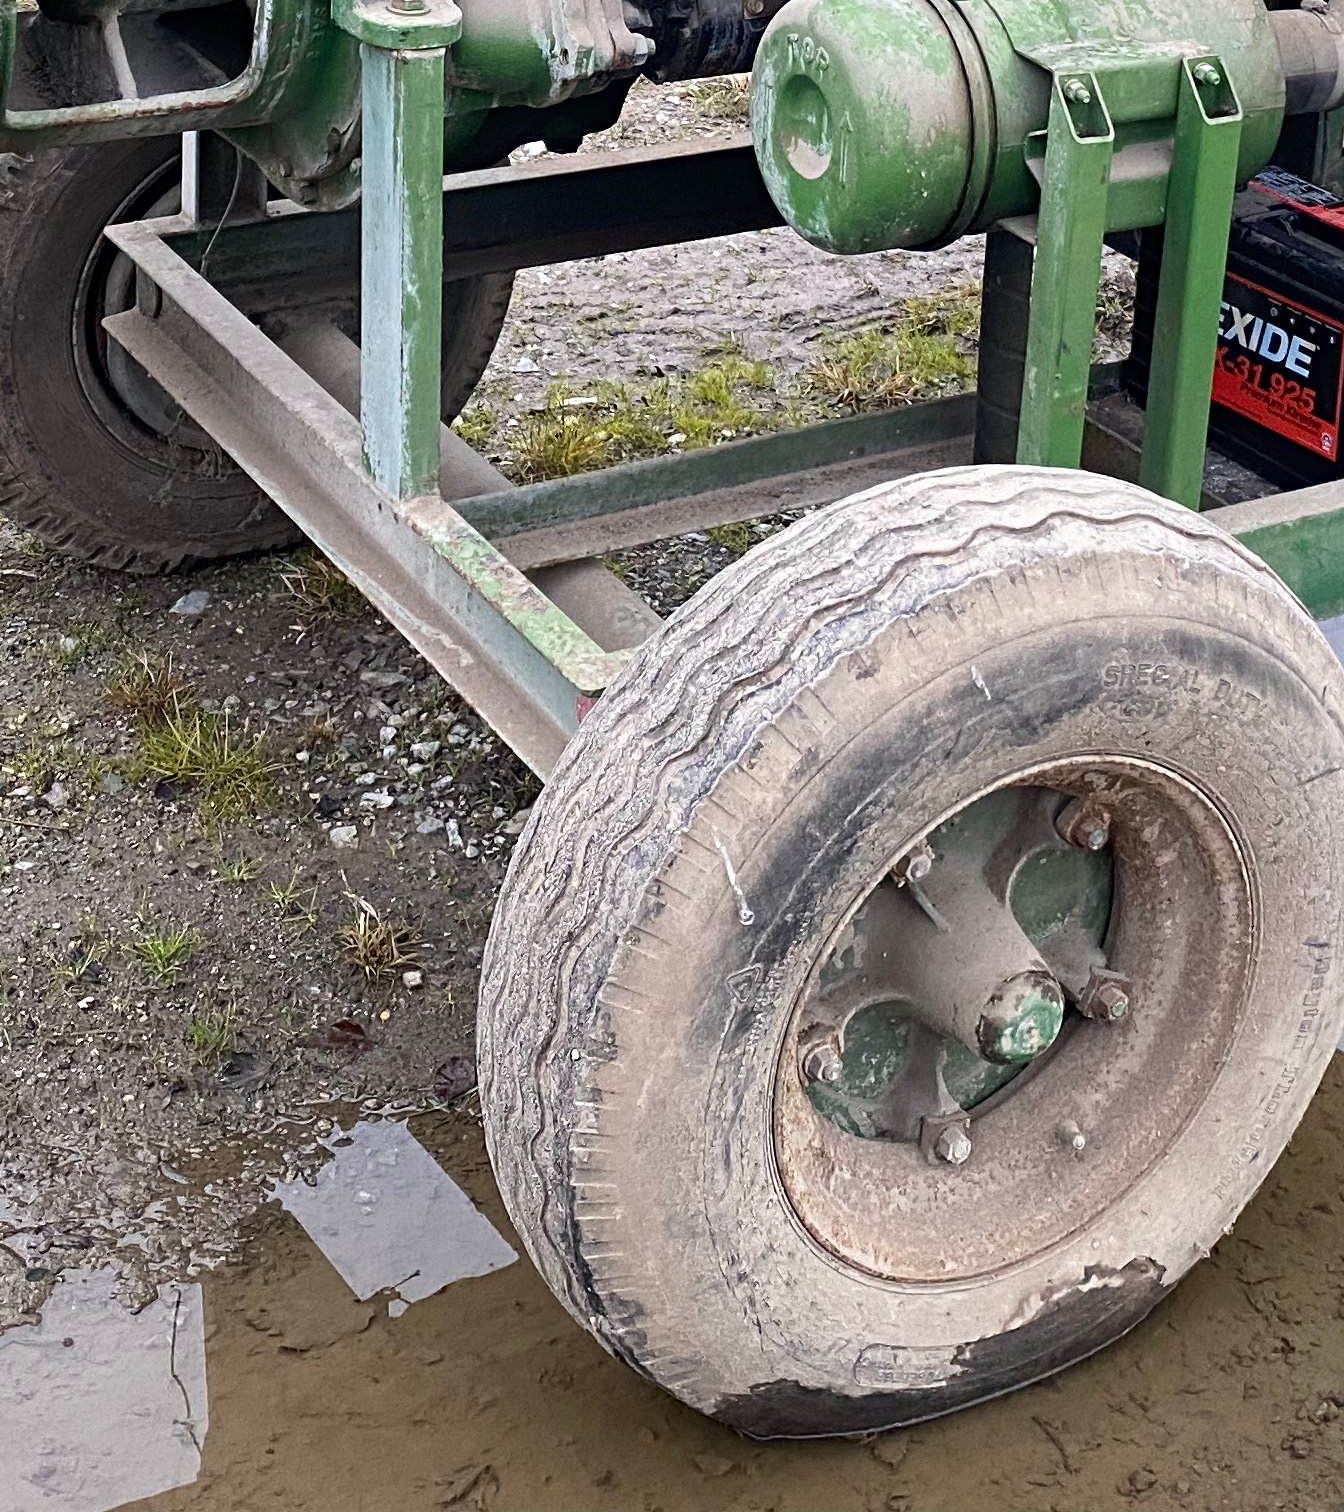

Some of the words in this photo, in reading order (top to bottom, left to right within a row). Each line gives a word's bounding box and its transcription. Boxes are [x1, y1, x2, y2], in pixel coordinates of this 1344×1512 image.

[786, 33, 830, 78] TOP
[1270, 372, 1317, 414] 925
[1102, 662, 1201, 695] SPECAL
[1215, 677, 1268, 713] DUT
